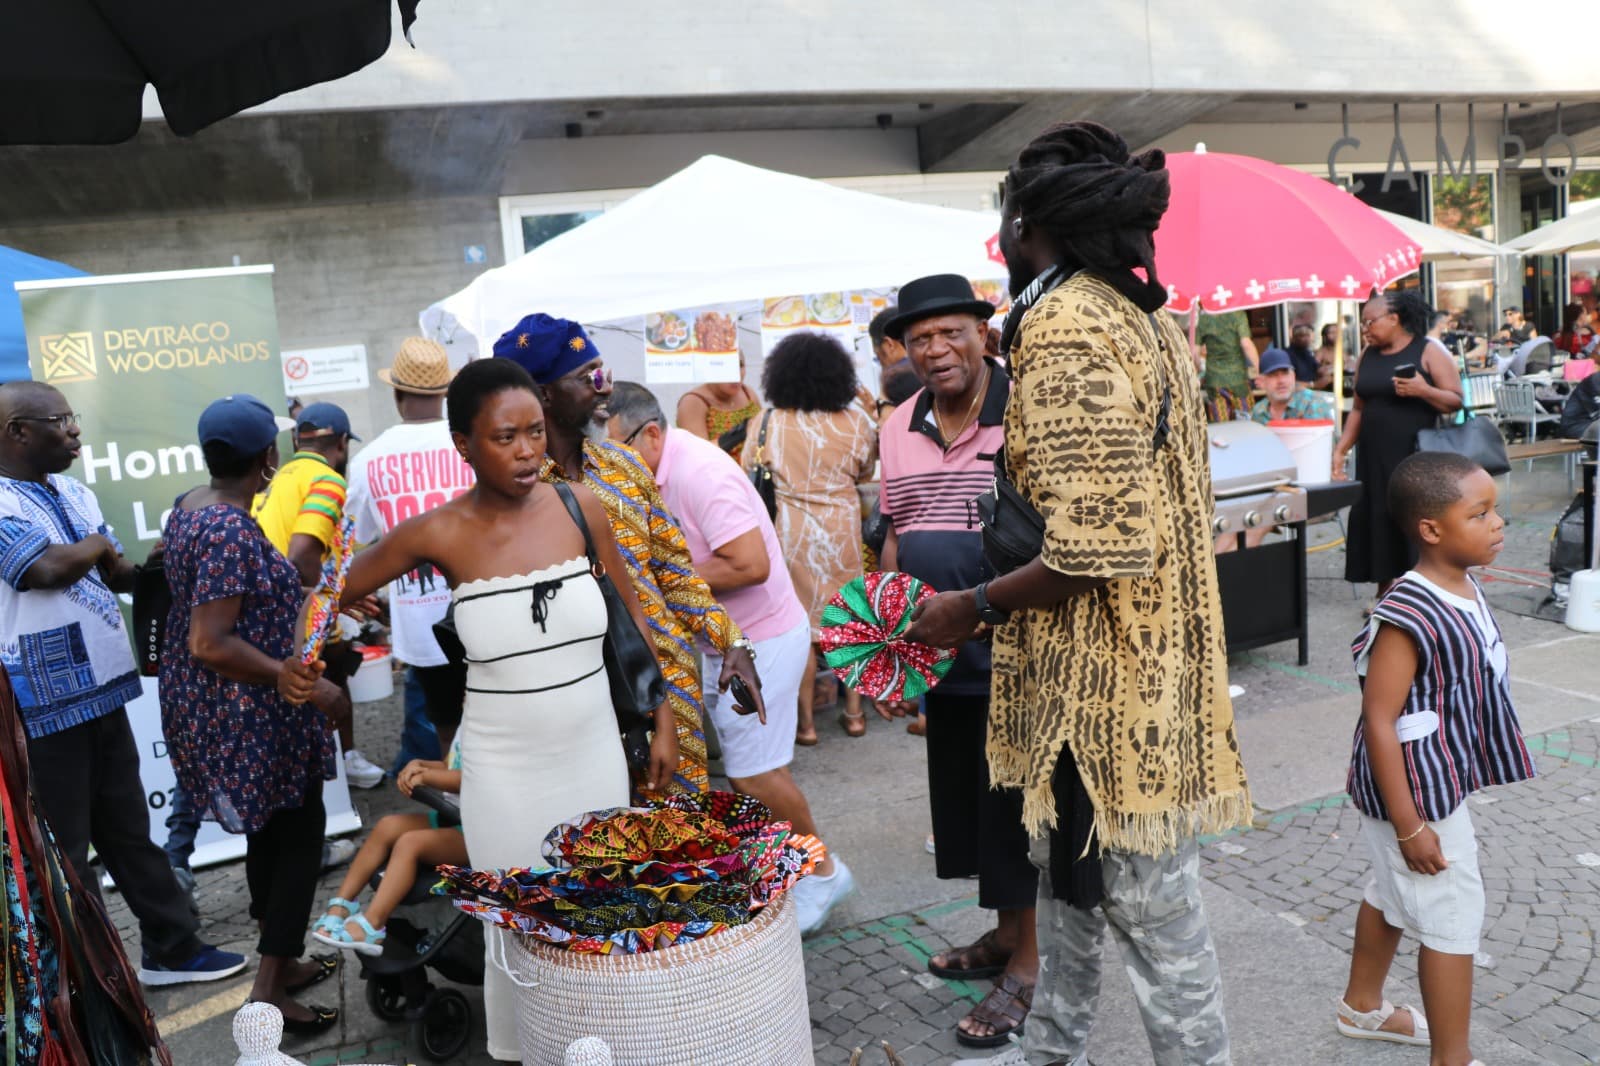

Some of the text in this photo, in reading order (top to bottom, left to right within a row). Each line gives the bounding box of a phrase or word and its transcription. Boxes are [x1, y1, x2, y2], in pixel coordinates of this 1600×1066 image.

[1328, 134, 1577, 193] CAMPO
[104, 321, 230, 350] DEVTRACO
[106, 340, 270, 375] WOODLANDS
[367, 448, 474, 499] RESERVOIR
